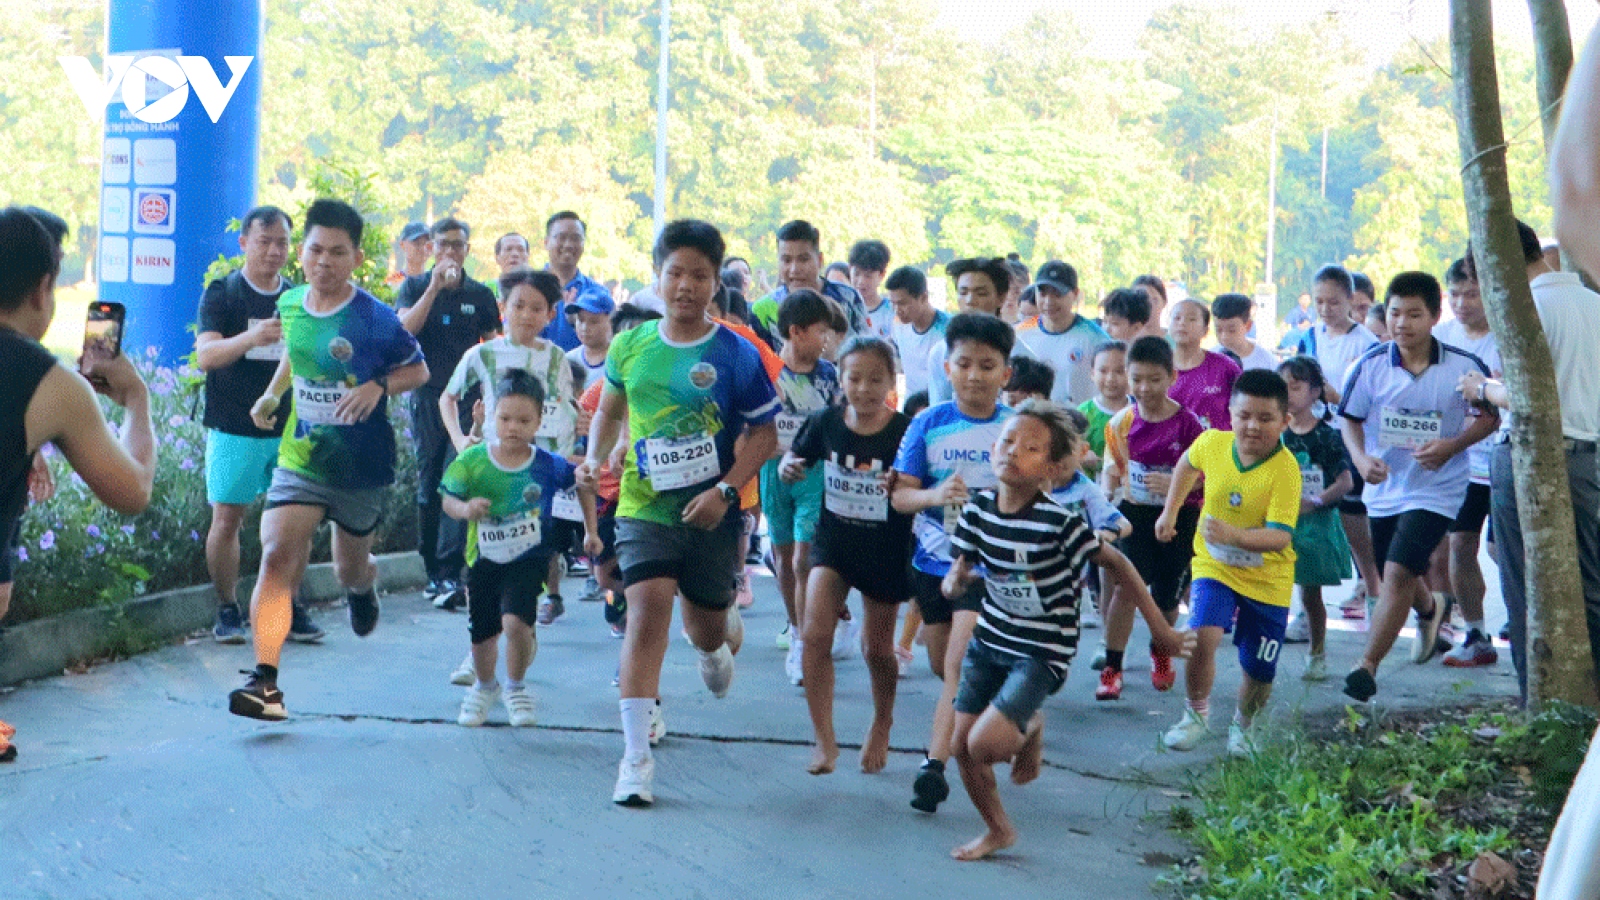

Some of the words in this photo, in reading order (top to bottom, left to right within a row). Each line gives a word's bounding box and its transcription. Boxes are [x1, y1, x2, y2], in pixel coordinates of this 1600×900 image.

[135, 255, 171, 267] KIRIN
[1384, 417, 1438, 432] 108-266
[652, 442, 713, 465] 108-220
[943, 449, 977, 462] UMC
[828, 476, 884, 496] 108-265
[482, 522, 536, 542] 108-221
[1257, 636, 1279, 662] 10
